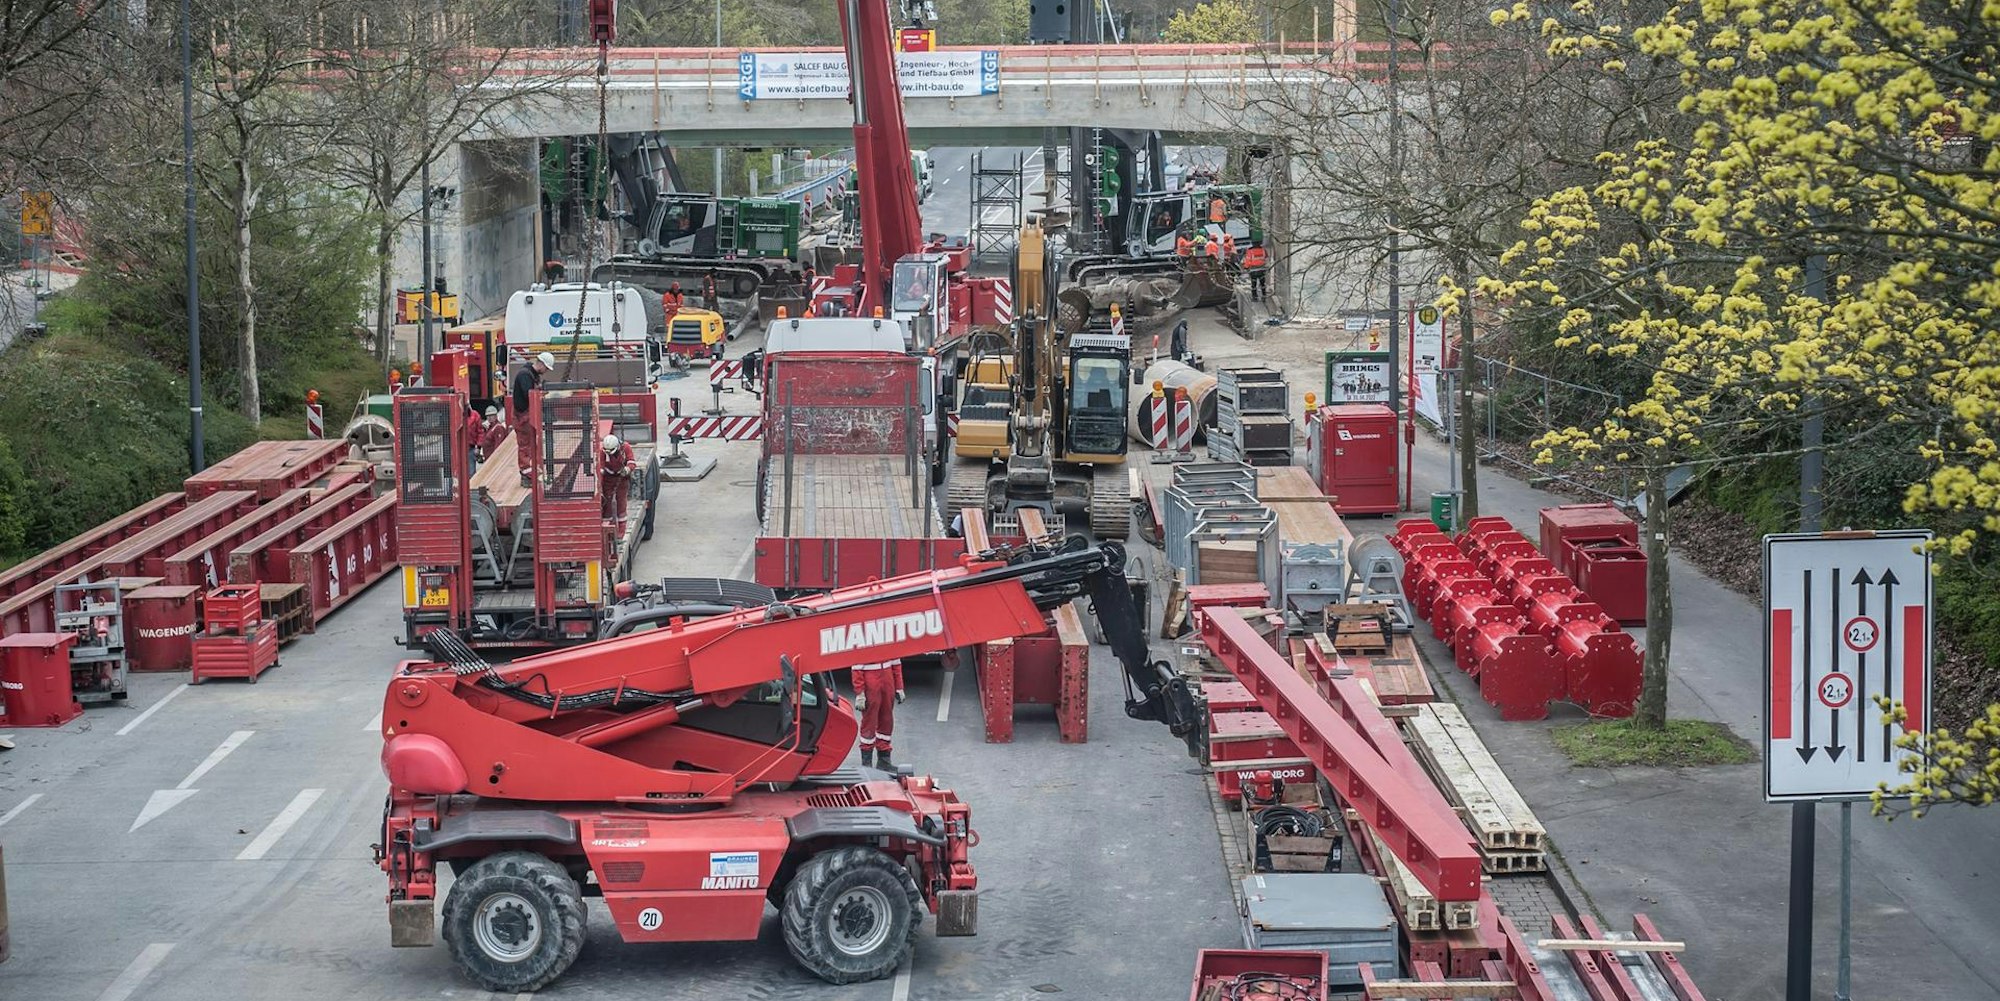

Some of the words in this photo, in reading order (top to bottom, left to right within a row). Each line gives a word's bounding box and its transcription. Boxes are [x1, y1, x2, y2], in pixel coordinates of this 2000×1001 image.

[794, 62, 820, 71] SALCEF
[822, 62, 839, 70] BAU
[984, 52, 997, 92] ARGE
[741, 54, 753, 96] ARGE
[139, 622, 198, 638] WAGENBOR
[820, 608, 943, 656] MANITOU
[1237, 769, 1305, 780] WANBORG
[701, 876, 759, 889] MANITO
[643, 912, 657, 927] 20
